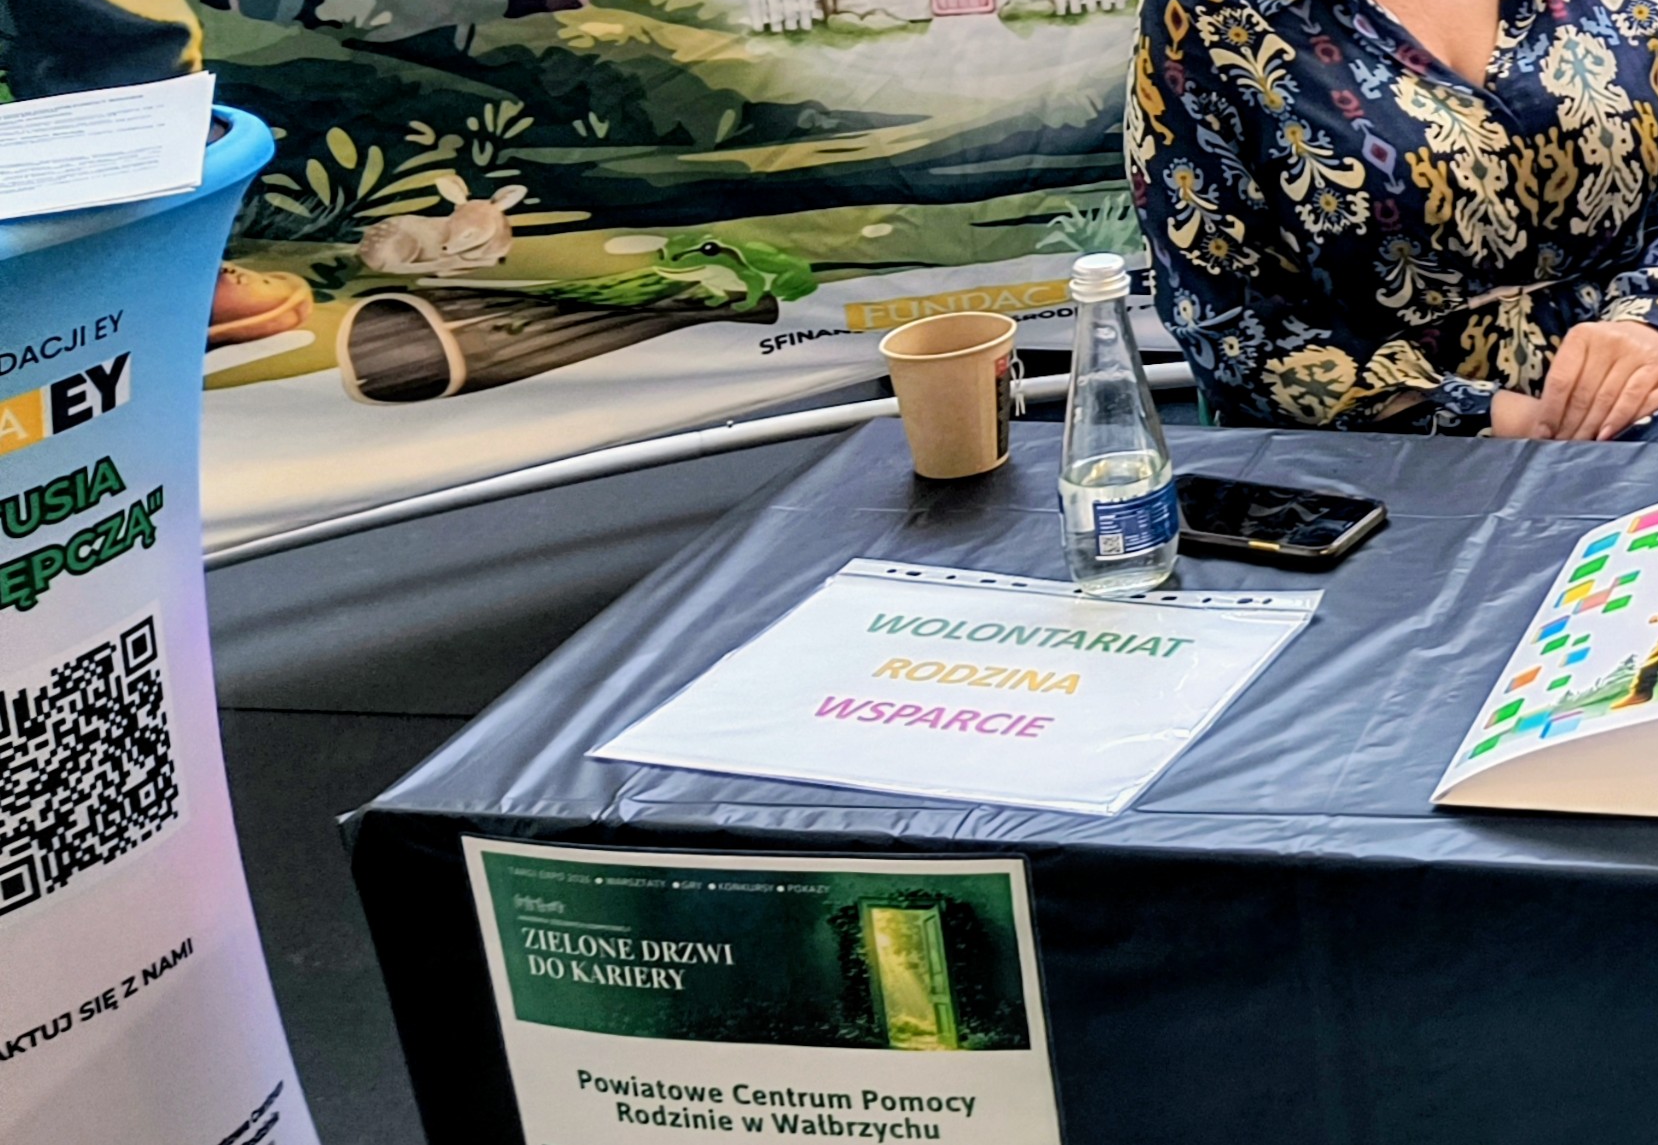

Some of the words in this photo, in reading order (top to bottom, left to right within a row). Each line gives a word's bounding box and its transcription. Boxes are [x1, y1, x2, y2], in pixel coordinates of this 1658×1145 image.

[95, 309, 124, 341] EY
[51, 351, 132, 435] EY
[866, 613, 1195, 659] WOLONTARIAT
[871, 657, 1081, 695] RODZINA
[814, 696, 1055, 739] WSPARCIE
[521, 927, 636, 961] ZIELONE
[642, 940, 736, 966] DRZWI
[79, 987, 119, 1022] SIĘ
[121, 975, 139, 999] Z
[141, 937, 194, 986] NAMI
[527, 954, 565, 980] DO
[571, 960, 686, 990] KARIERY
[577, 1069, 723, 1104] Powiatowe
[732, 1084, 852, 1110] Centrum
[862, 1089, 976, 1118] Pomocy
[616, 1102, 733, 1131] Rodzinie
[742, 1116, 764, 1133] w
